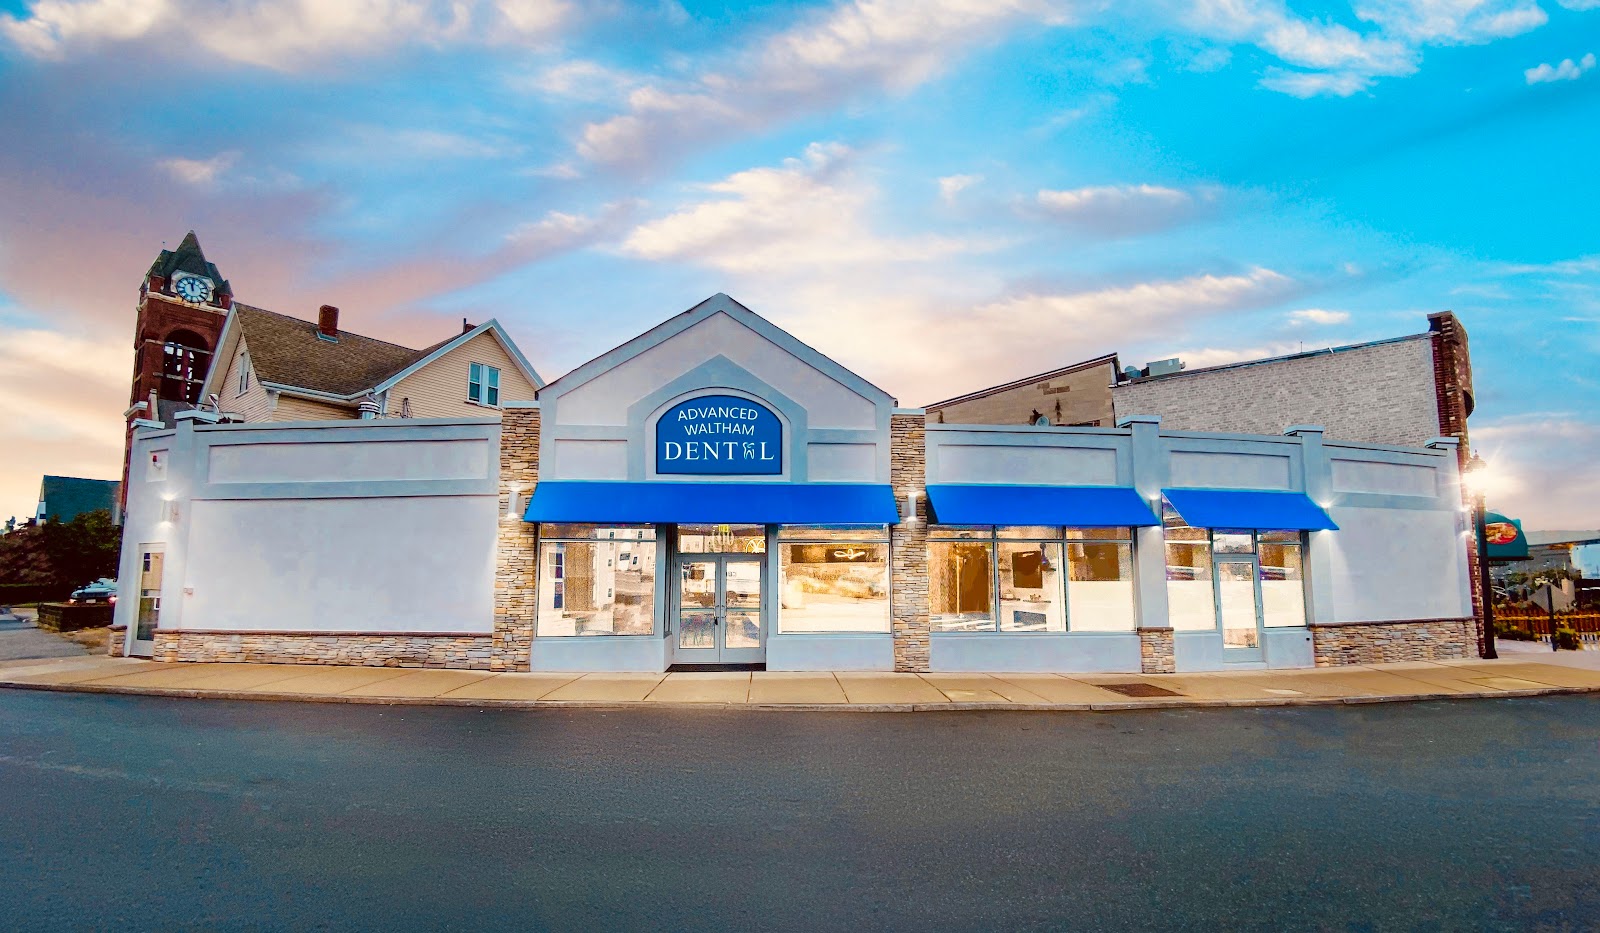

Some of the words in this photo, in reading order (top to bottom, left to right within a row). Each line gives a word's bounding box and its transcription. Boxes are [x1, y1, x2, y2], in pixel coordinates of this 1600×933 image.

[678, 407, 758, 421] ADVANCED
[684, 422, 755, 436] WALTHAM
[664, 441, 775, 460] DENTL
